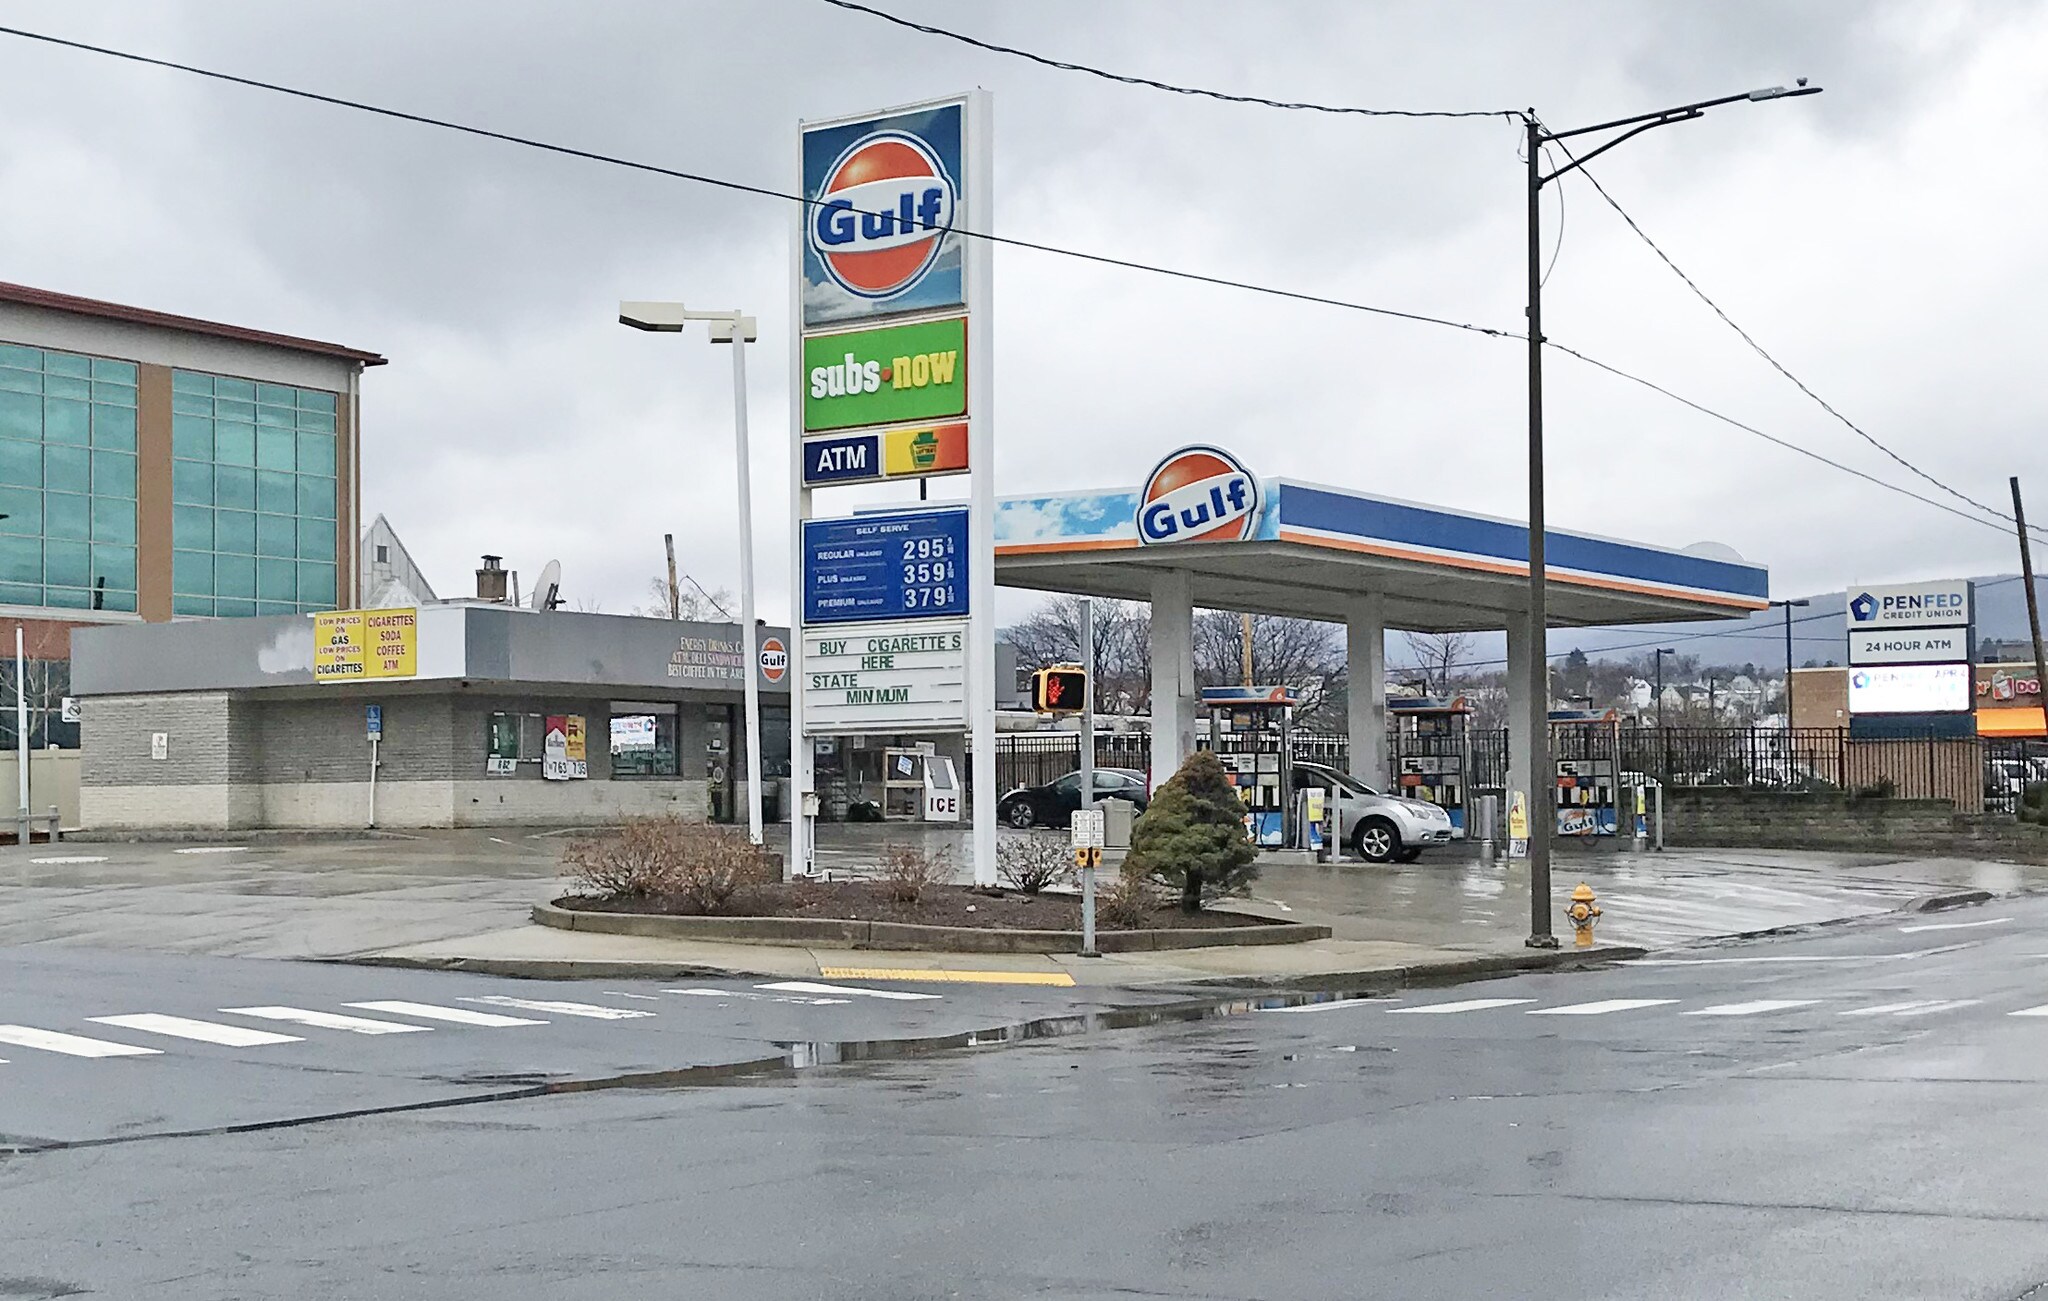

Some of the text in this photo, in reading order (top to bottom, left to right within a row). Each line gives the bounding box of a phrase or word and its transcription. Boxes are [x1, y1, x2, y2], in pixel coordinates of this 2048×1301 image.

[817, 187, 943, 246] Gulf
[817, 444, 867, 473] ATM
[1143, 477, 1246, 540] Gulf
[856, 523, 910, 536] SELF SERVE
[817, 549, 855, 560] REGULAR
[903, 538, 945, 560] 295
[817, 574, 839, 584] PLUS
[903, 562, 945, 584] 359
[817, 597, 856, 608] PREMIUM
[904, 586, 947, 608] 379
[1882, 592, 1963, 610] PENFED
[319, 616, 361, 626] LOW PRICES
[367, 614, 415, 628] CIGARETTES
[1883, 609, 1962, 620] CREDIT UNION
[335, 626, 346, 634] ON
[380, 630, 402, 642] SODA
[331, 635, 350, 646] GAS
[1865, 640, 1952, 653] 24 HOUR ATM
[319, 645, 361, 654] LOW PRICES
[376, 644, 406, 657] COFFEE
[819, 640, 847, 656] BUY
[334, 655, 346, 663] ON
[382, 659, 399, 671] ATM
[761, 653, 786, 666] Gulf
[861, 655, 894, 670] HERE
[316, 662, 363, 675] CIGARETTES
[729, 667, 745, 679] ARE
[812, 673, 858, 688] STATE
[930, 797, 956, 813] ICE
